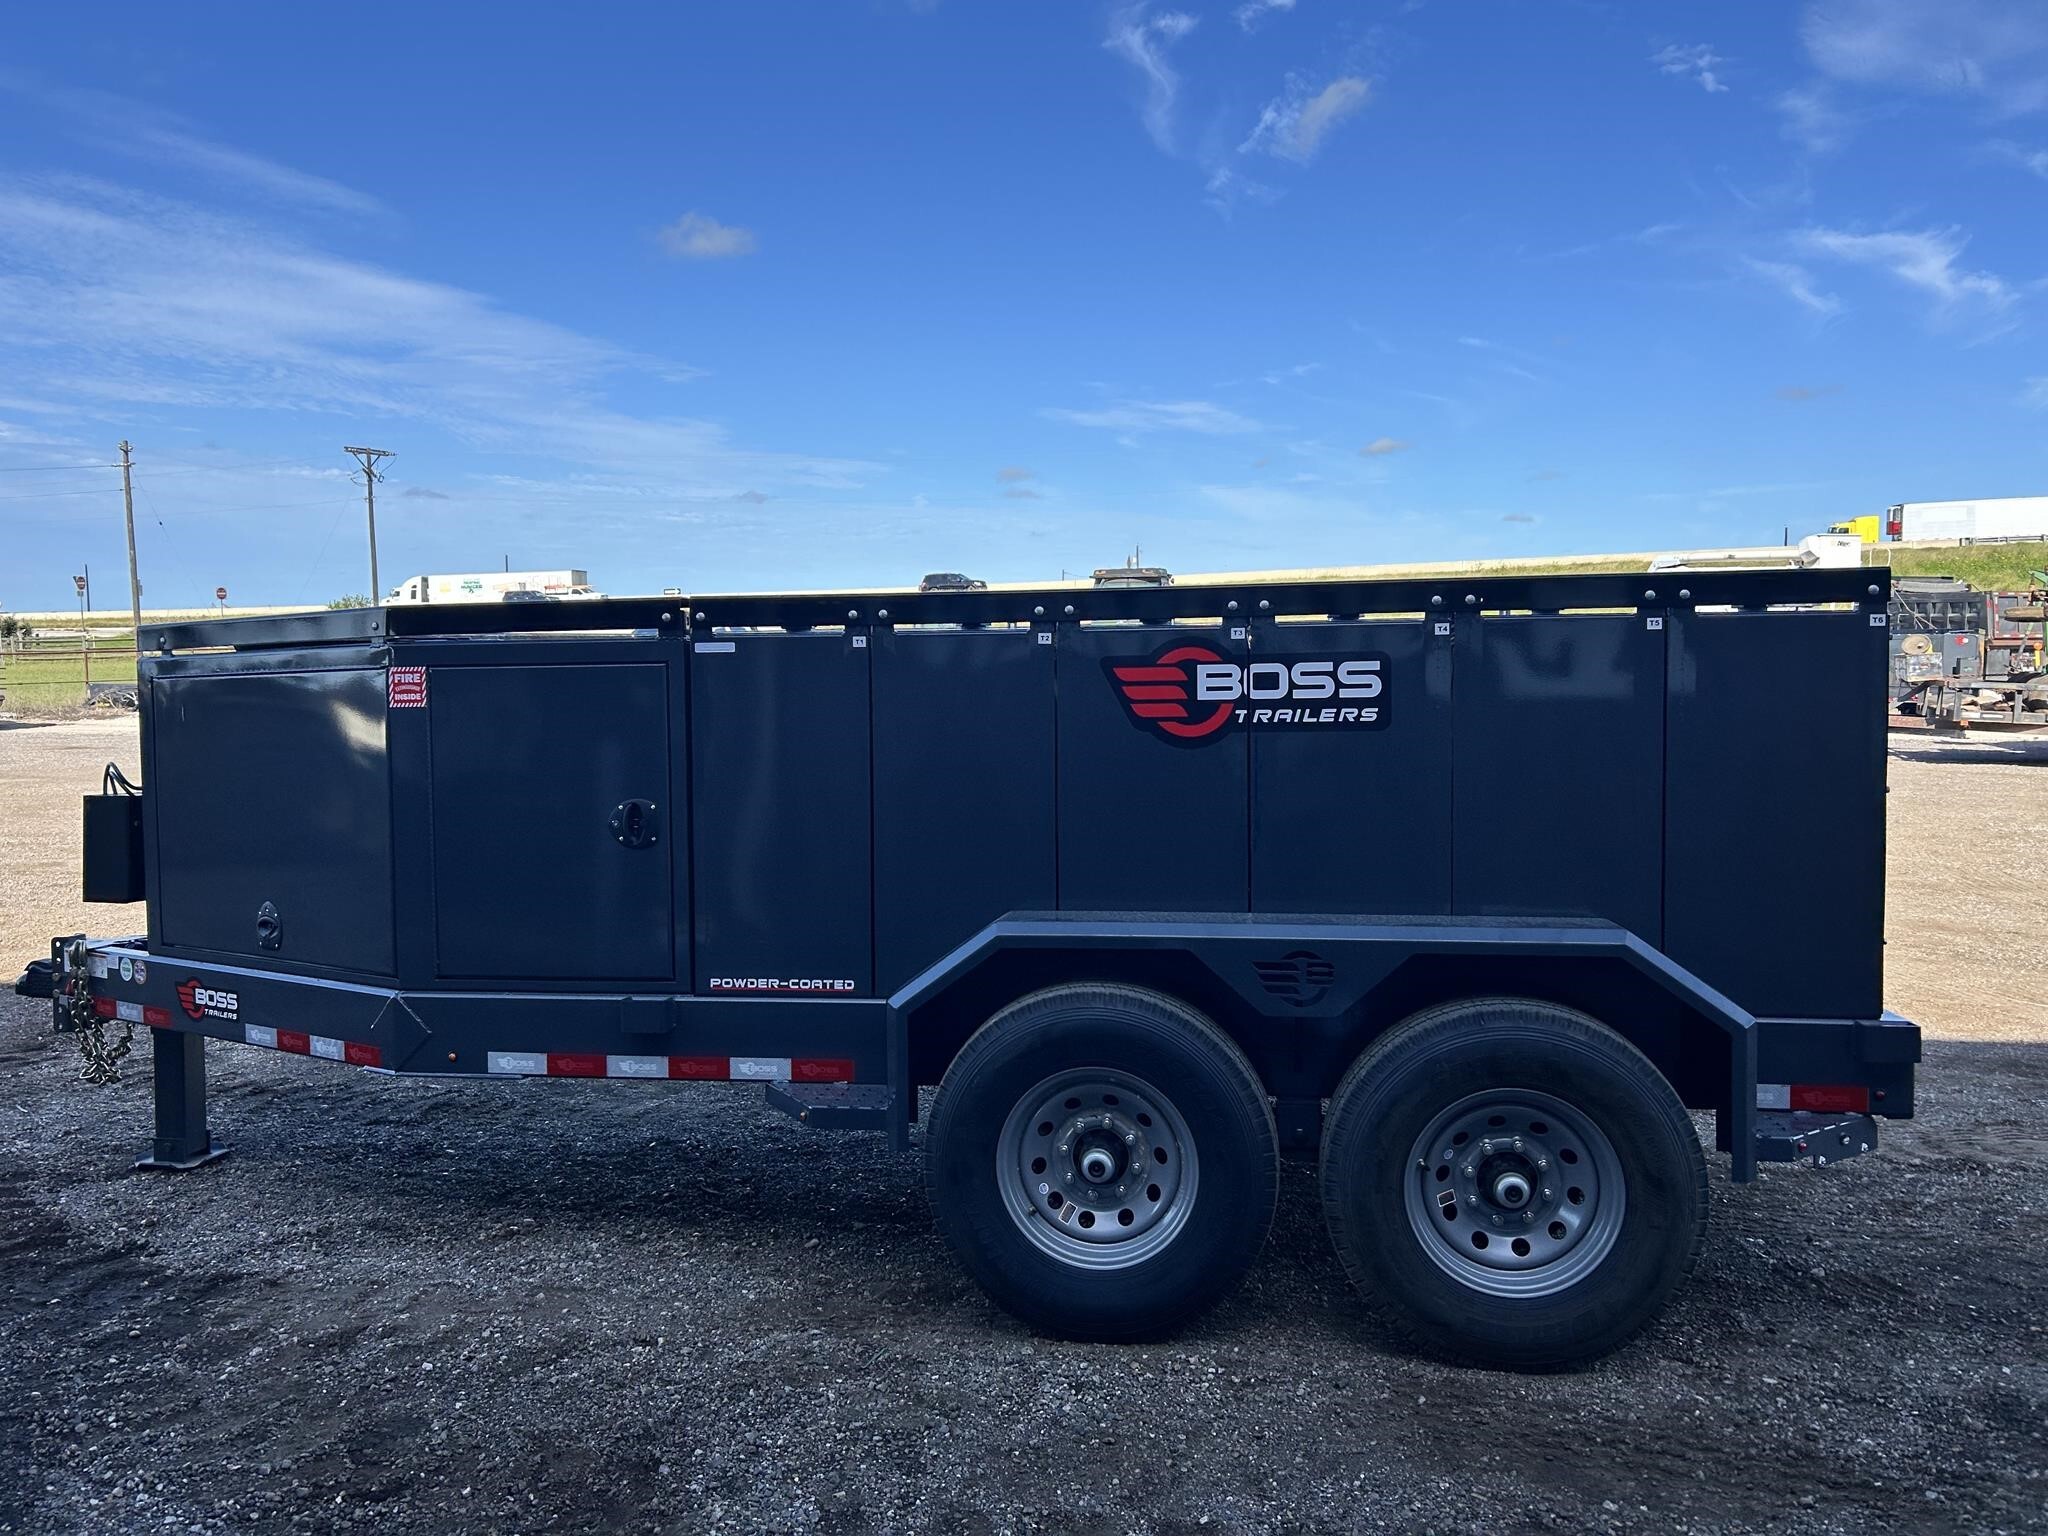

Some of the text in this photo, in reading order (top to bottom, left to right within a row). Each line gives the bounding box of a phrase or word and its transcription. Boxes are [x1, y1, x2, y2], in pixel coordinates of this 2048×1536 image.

[394, 673, 421, 683] FIRE
[1197, 660, 1383, 700] BOSS
[394, 693, 422, 701] INSIDE
[1235, 707, 1380, 723] TRAILERS
[710, 978, 855, 990] POWDER-COATED
[195, 988, 238, 1010] BOSS
[204, 1008, 238, 1020] TRAILERS
